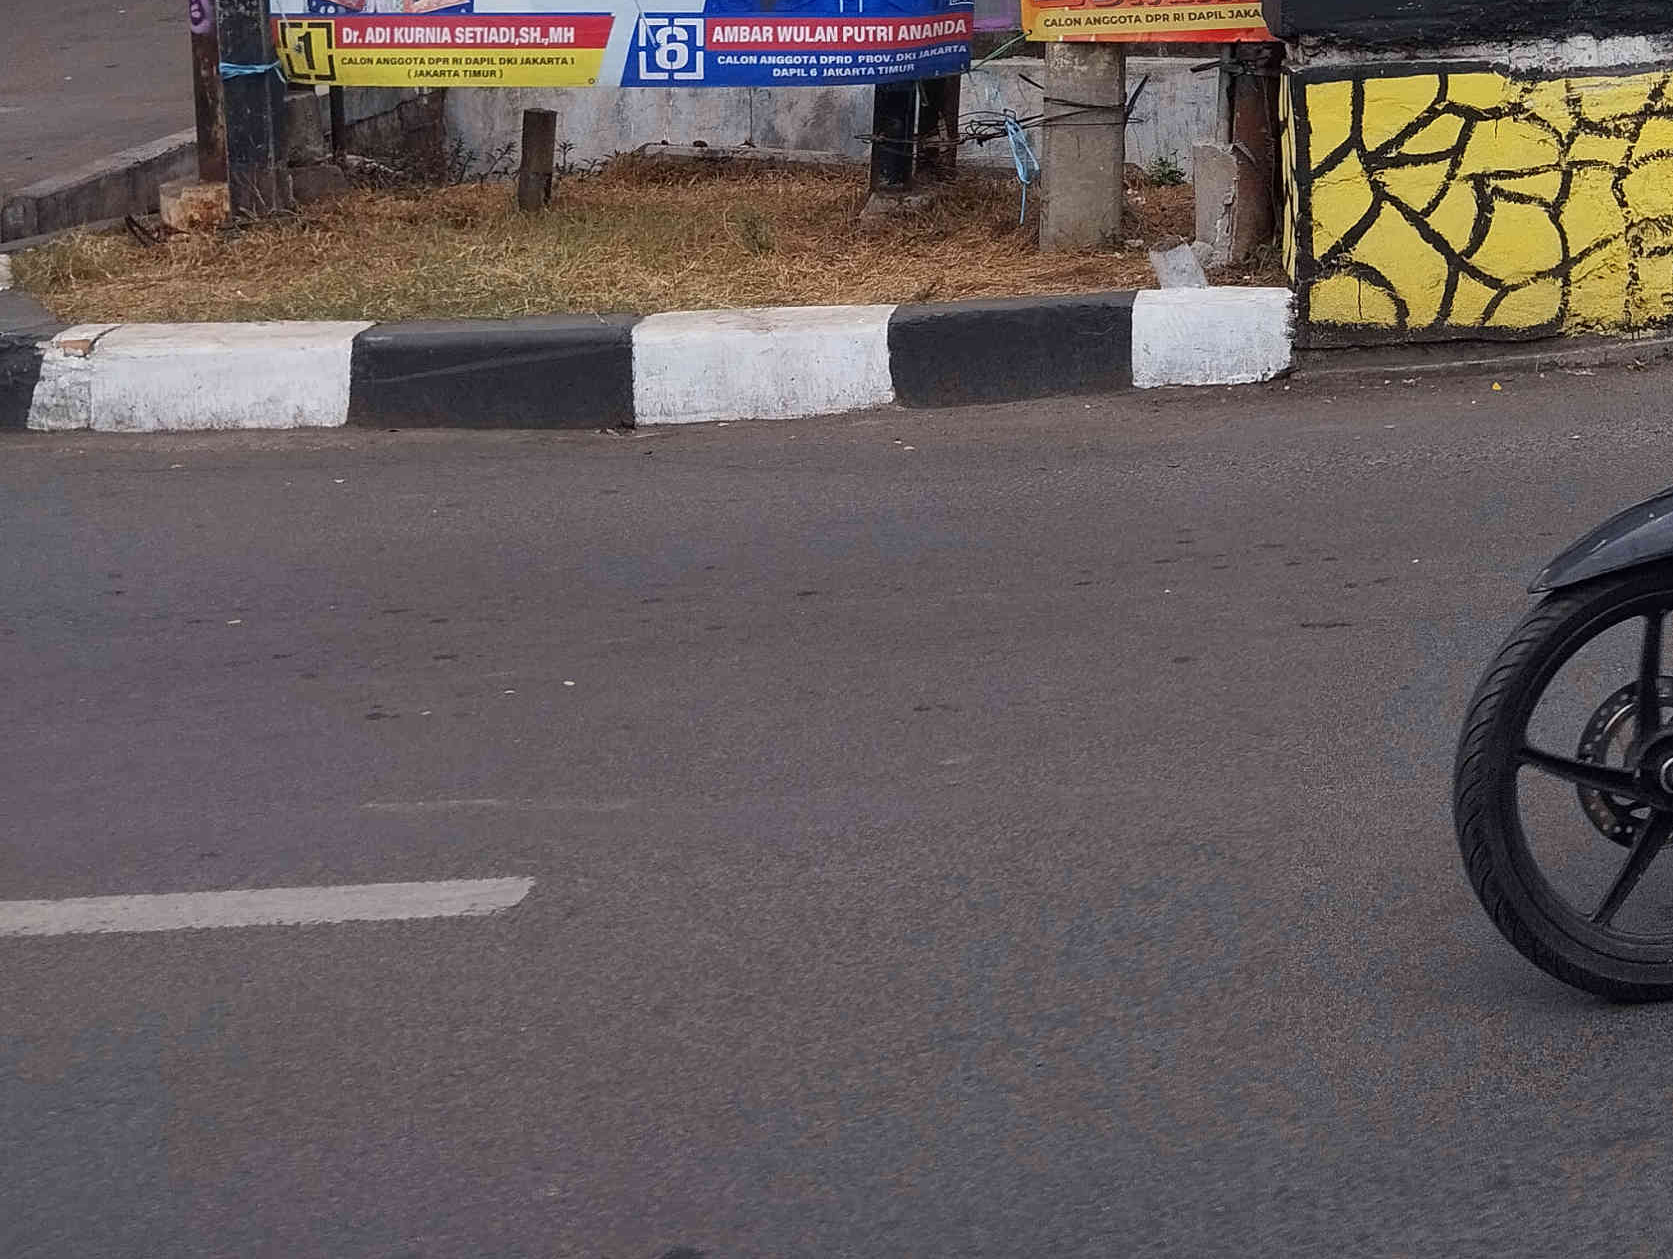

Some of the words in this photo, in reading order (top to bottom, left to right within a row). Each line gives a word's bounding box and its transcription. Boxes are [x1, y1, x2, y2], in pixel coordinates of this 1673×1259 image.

[1044, 16, 1083, 28] CALON
[1085, 14, 1142, 27] ANGGOTA
[1145, 12, 1170, 24] DPR
[1173, 11, 1185, 22] RI
[1188, 9, 1226, 21] DAPIL
[342, 27, 364, 45] Dr.
[365, 27, 391, 45] ADI
[394, 26, 451, 45] KURNIA
[711, 24, 774, 45] AMBAR
[776, 23, 841, 44] WULAN
[843, 23, 895, 43] PUTRI
[897, 18, 967, 41] ANANDA
[655, 25, 689, 71] 6
[717, 54, 756, 66] CALON
[758, 54, 817, 66] ANGGOTA
[819, 54, 853, 65] DPRD
[858, 53, 894, 65] PROV.
[896, 50, 917, 63] DKI
[918, 43, 968, 61] JAKARTA
[340, 56, 374, 66] CALON
[375, 56, 425, 66] ANGGOTA
[427, 56, 450, 66] DPR
[452, 56, 463, 66] RI
[464, 56, 497, 66] DAPIL
[498, 56, 517, 66] DKI
[519, 56, 567, 66] JAKARTA
[772, 67, 809, 78] DAPIL
[810, 67, 818, 77] 6
[822, 66, 876, 78] JAKARTA
[878, 63, 916, 76] TIMUR
[413, 69, 460, 79] JAKARTA
[462, 69, 498, 79] TIMUR
